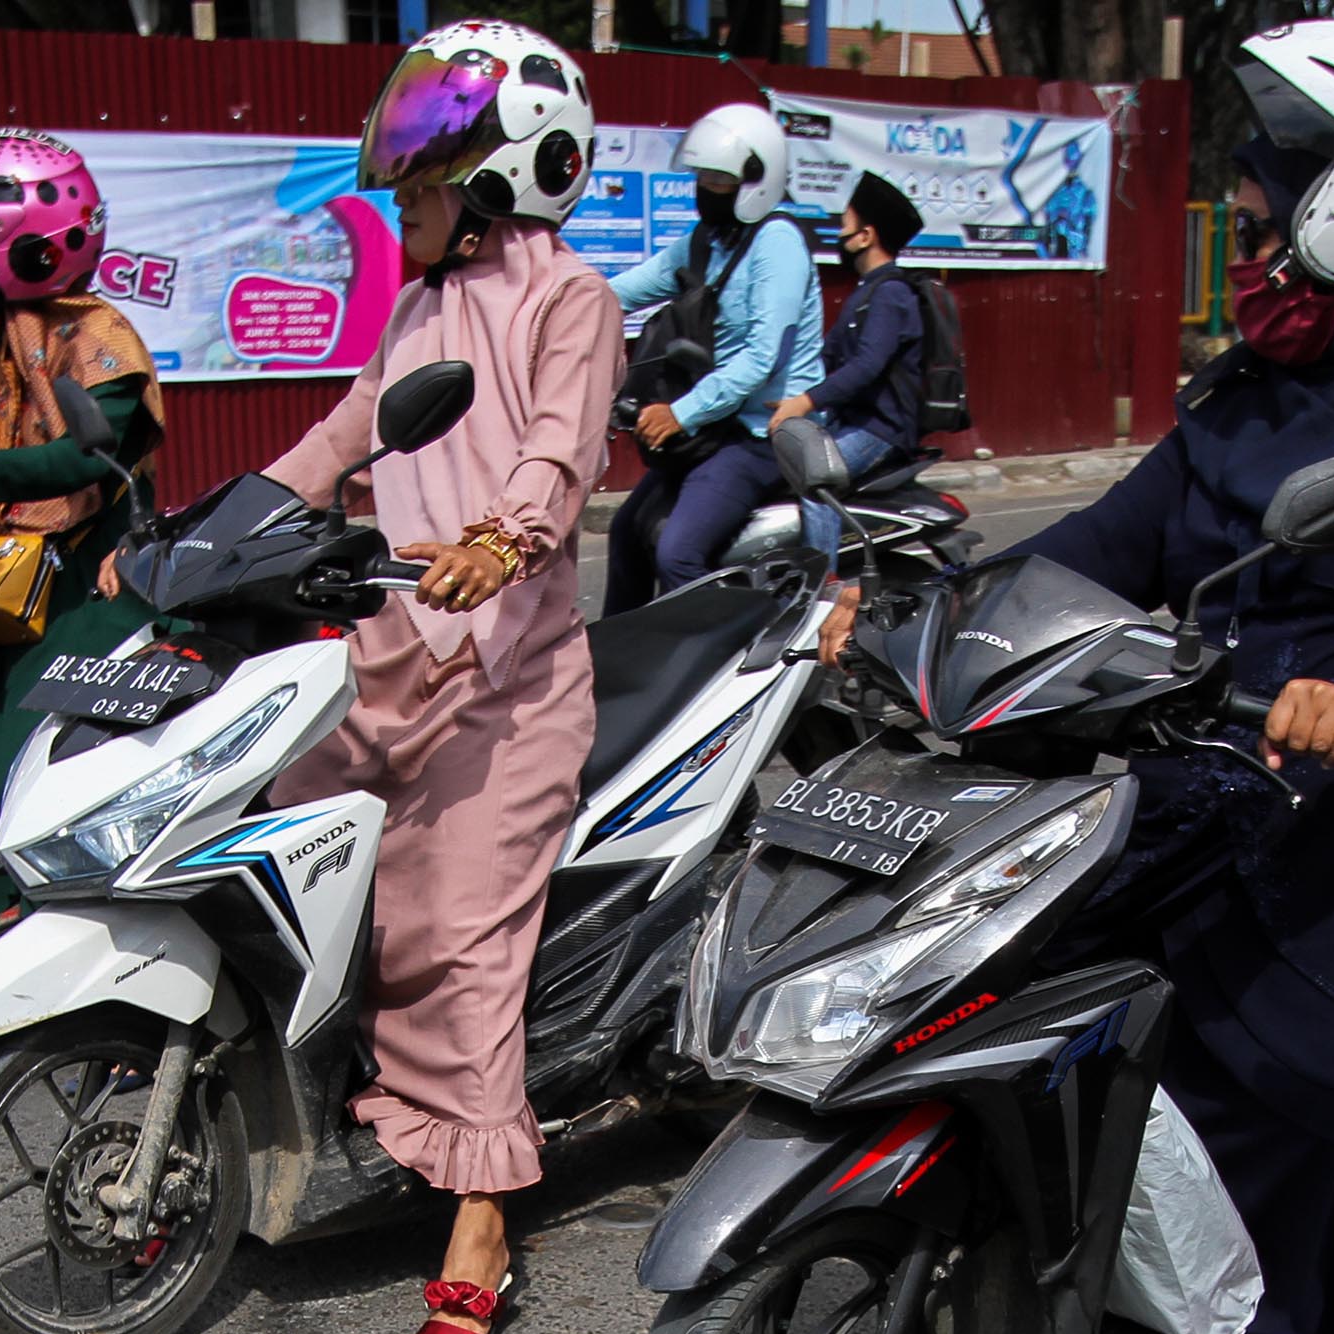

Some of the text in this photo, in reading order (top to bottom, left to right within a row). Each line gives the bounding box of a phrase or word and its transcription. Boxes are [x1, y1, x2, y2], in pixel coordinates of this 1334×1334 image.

[173, 539, 214, 551] HONDA
[954, 631, 1014, 653] HONDA
[41, 655, 190, 694] BL 5037 KAE
[773, 779, 943, 843] BL 3853 KB
[285, 820, 358, 866] HONDA
[302, 836, 357, 895] FI
[892, 992, 999, 1055] HONDA
